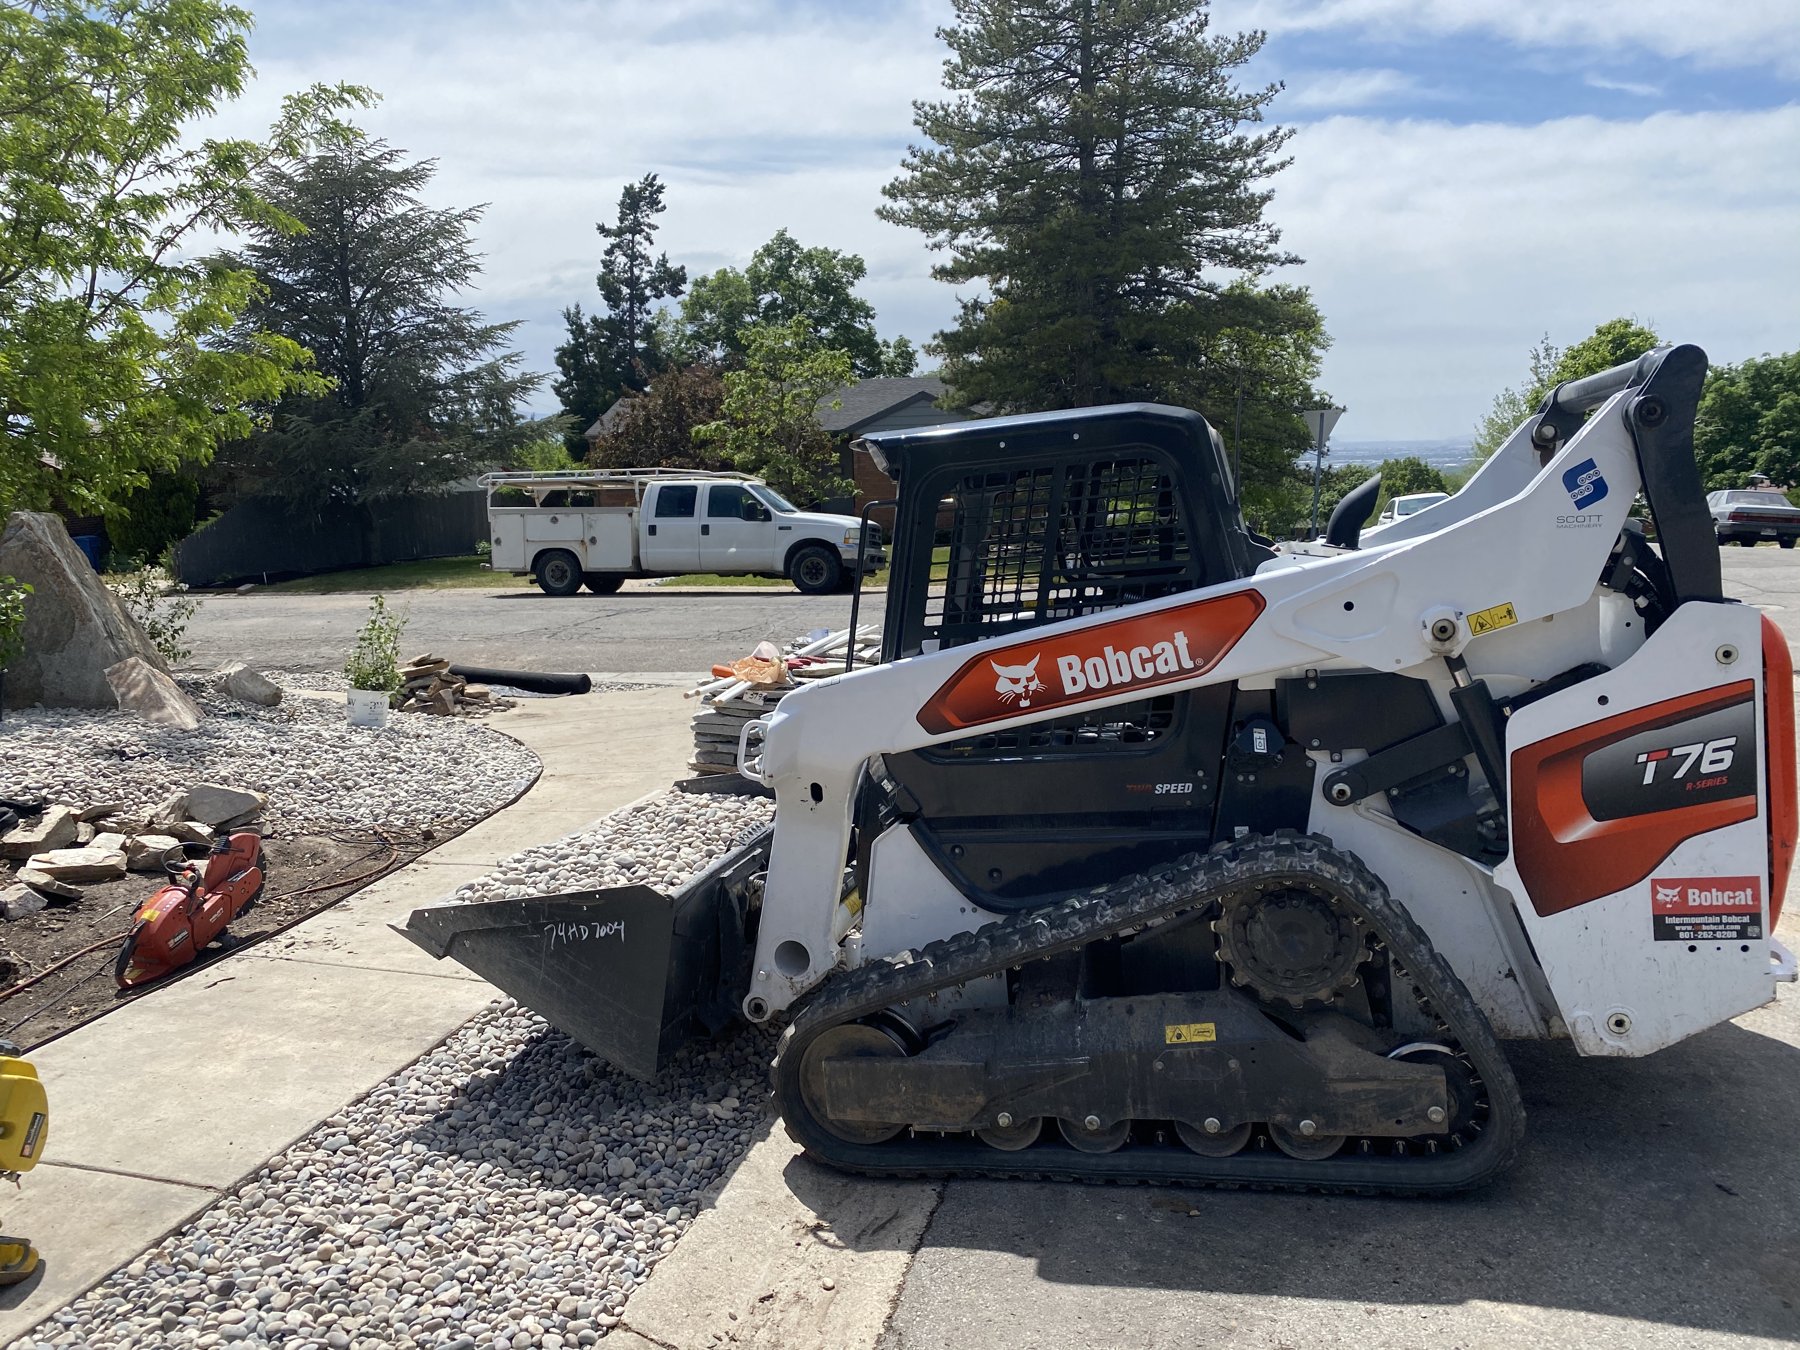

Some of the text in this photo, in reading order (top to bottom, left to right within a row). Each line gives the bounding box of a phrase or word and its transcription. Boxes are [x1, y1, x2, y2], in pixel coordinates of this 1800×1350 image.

[1556, 514, 1603, 524] SCOTT
[1056, 630, 1194, 696] Bobcat
[1637, 736, 1737, 785] T76
[1154, 783, 1193, 795] SPEED
[1685, 776, 1728, 791] R-SERIES
[1687, 888, 1753, 906] Bobcat
[1665, 915, 1750, 924] Intermountain Bobcat
